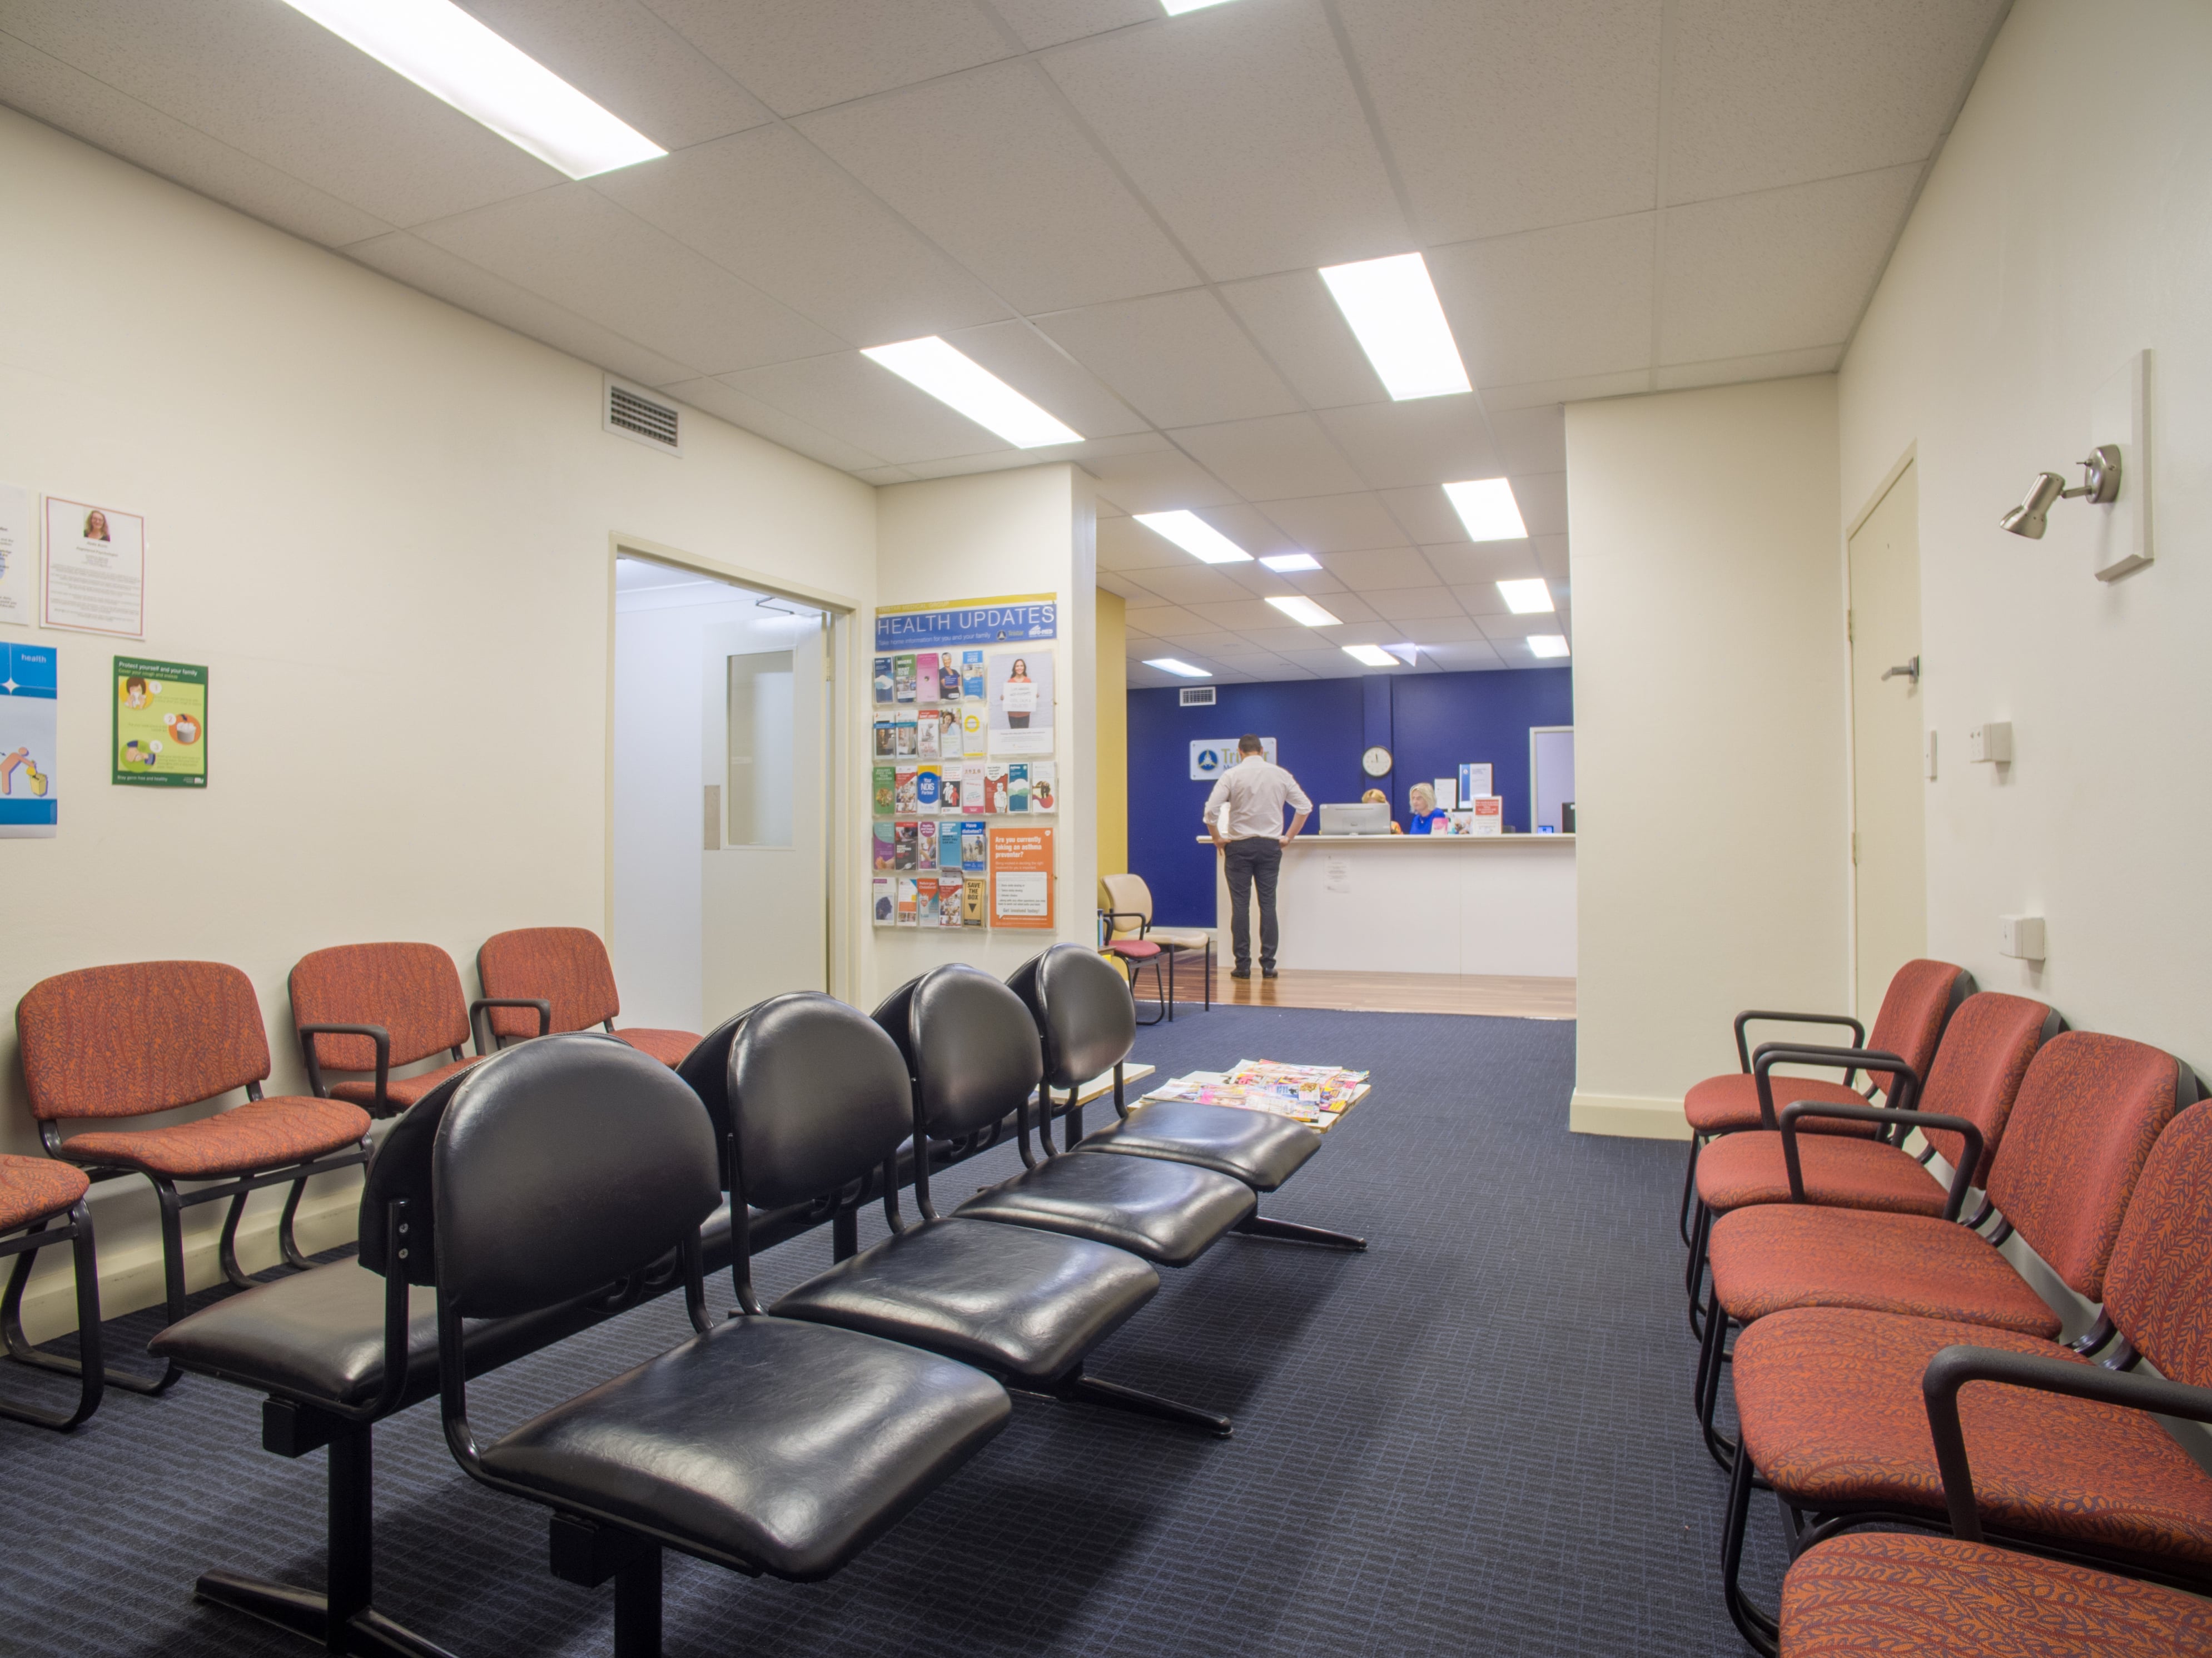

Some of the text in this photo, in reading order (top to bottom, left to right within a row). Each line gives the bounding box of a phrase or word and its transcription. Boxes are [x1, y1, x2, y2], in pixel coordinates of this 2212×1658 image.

[878, 606, 1055, 635] HEALTH UPDATES
[22, 653, 47, 663] health
[182, 669, 198, 677] family
[1221, 748, 1269, 763] Trir
[996, 844, 1012, 852] taking
